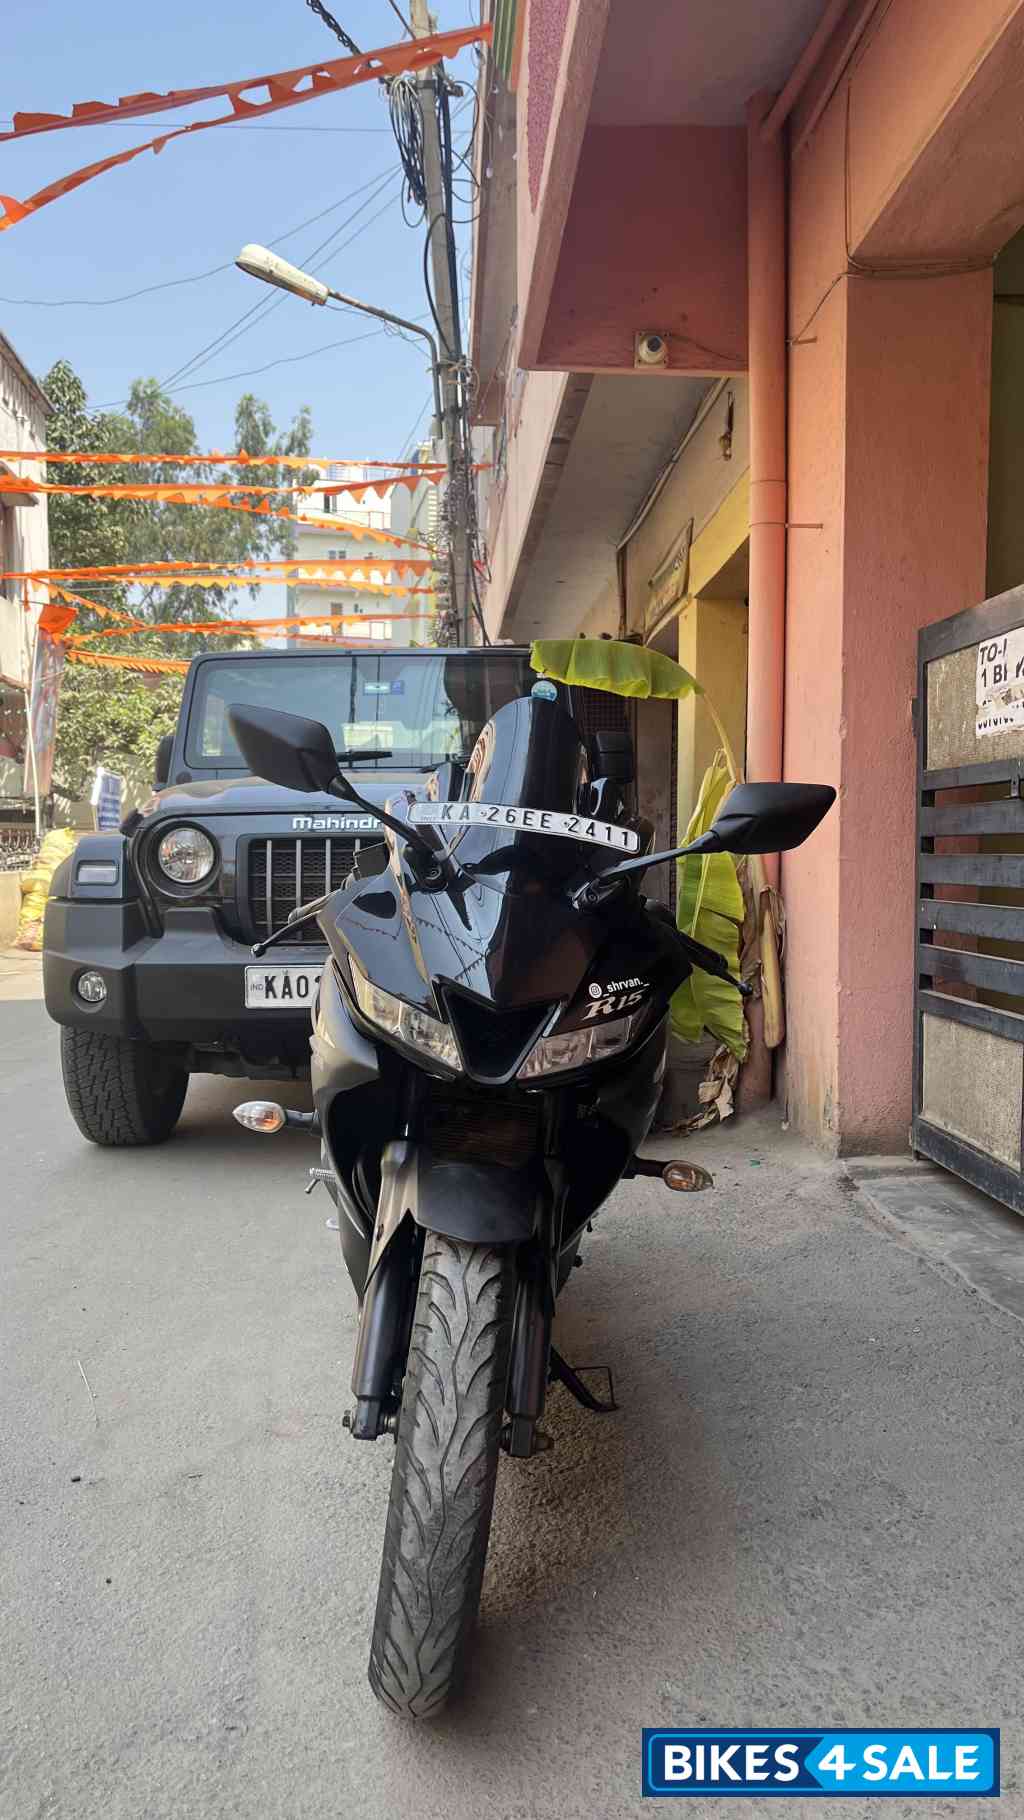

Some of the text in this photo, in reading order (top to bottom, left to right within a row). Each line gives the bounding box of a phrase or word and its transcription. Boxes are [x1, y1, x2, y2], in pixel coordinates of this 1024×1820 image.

[981, 668, 987, 688] 1
[441, 804, 629, 846] KA 26EE 2411
[582, 987, 648, 1021] R15
